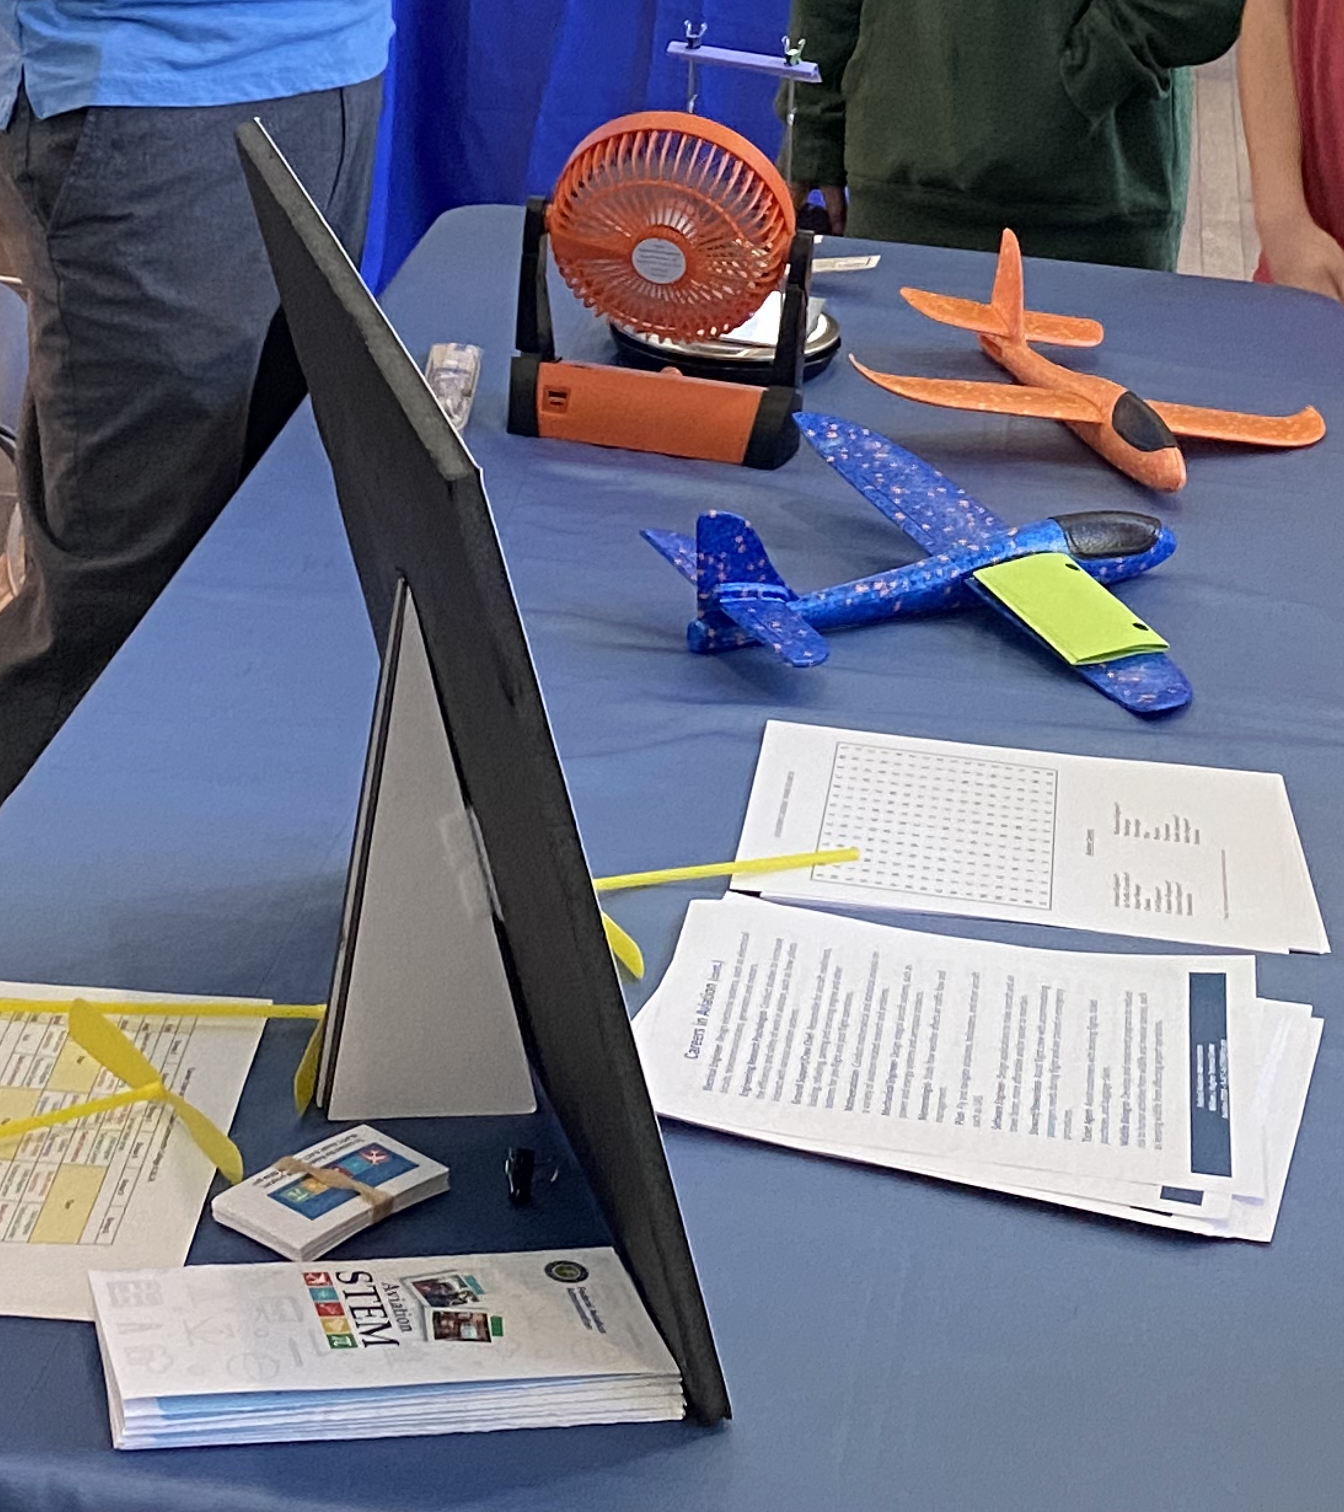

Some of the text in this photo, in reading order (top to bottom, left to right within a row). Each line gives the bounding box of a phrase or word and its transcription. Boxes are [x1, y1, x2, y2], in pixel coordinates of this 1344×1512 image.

[694, 981, 717, 1017] Aviation
[691, 1017, 708, 1026] in
[683, 1027, 705, 1059] Careers
[335, 1270, 400, 1348] STEM
[381, 1281, 413, 1333] Aviation
